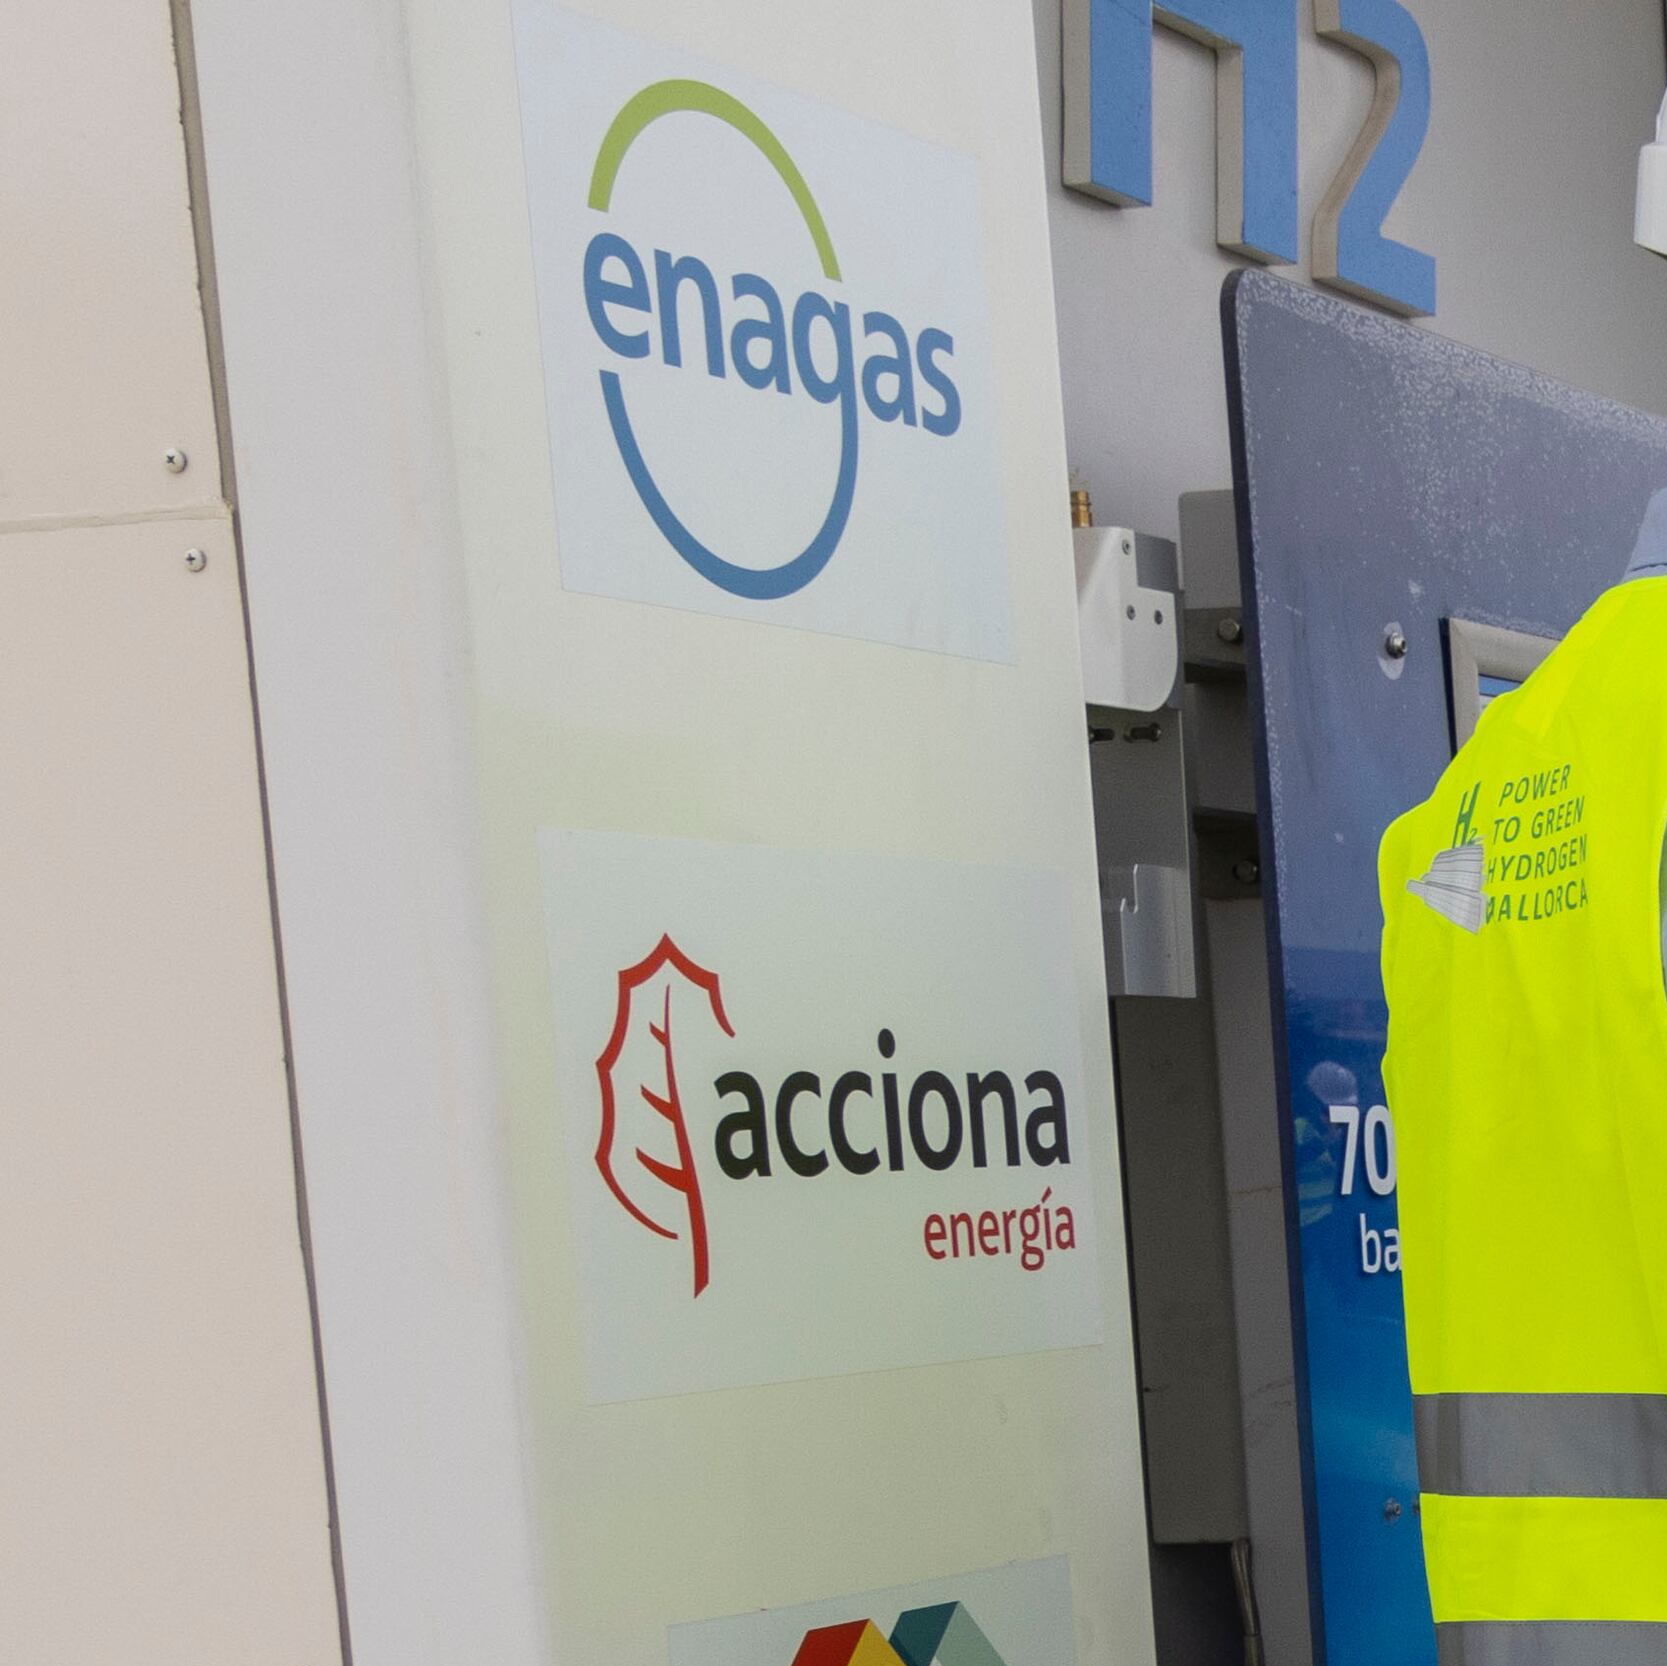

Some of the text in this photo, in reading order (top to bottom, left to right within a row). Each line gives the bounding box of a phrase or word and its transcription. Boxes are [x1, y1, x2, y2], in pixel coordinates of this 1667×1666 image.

[583, 232, 962, 437] enagas
[1498, 764, 1571, 807] POWER
[1493, 795, 1585, 845] TO GREEN
[1486, 833, 1588, 884] HYDROGEN
[712, 1028, 1071, 1181] acciona
[923, 1186, 1077, 1272] energía
